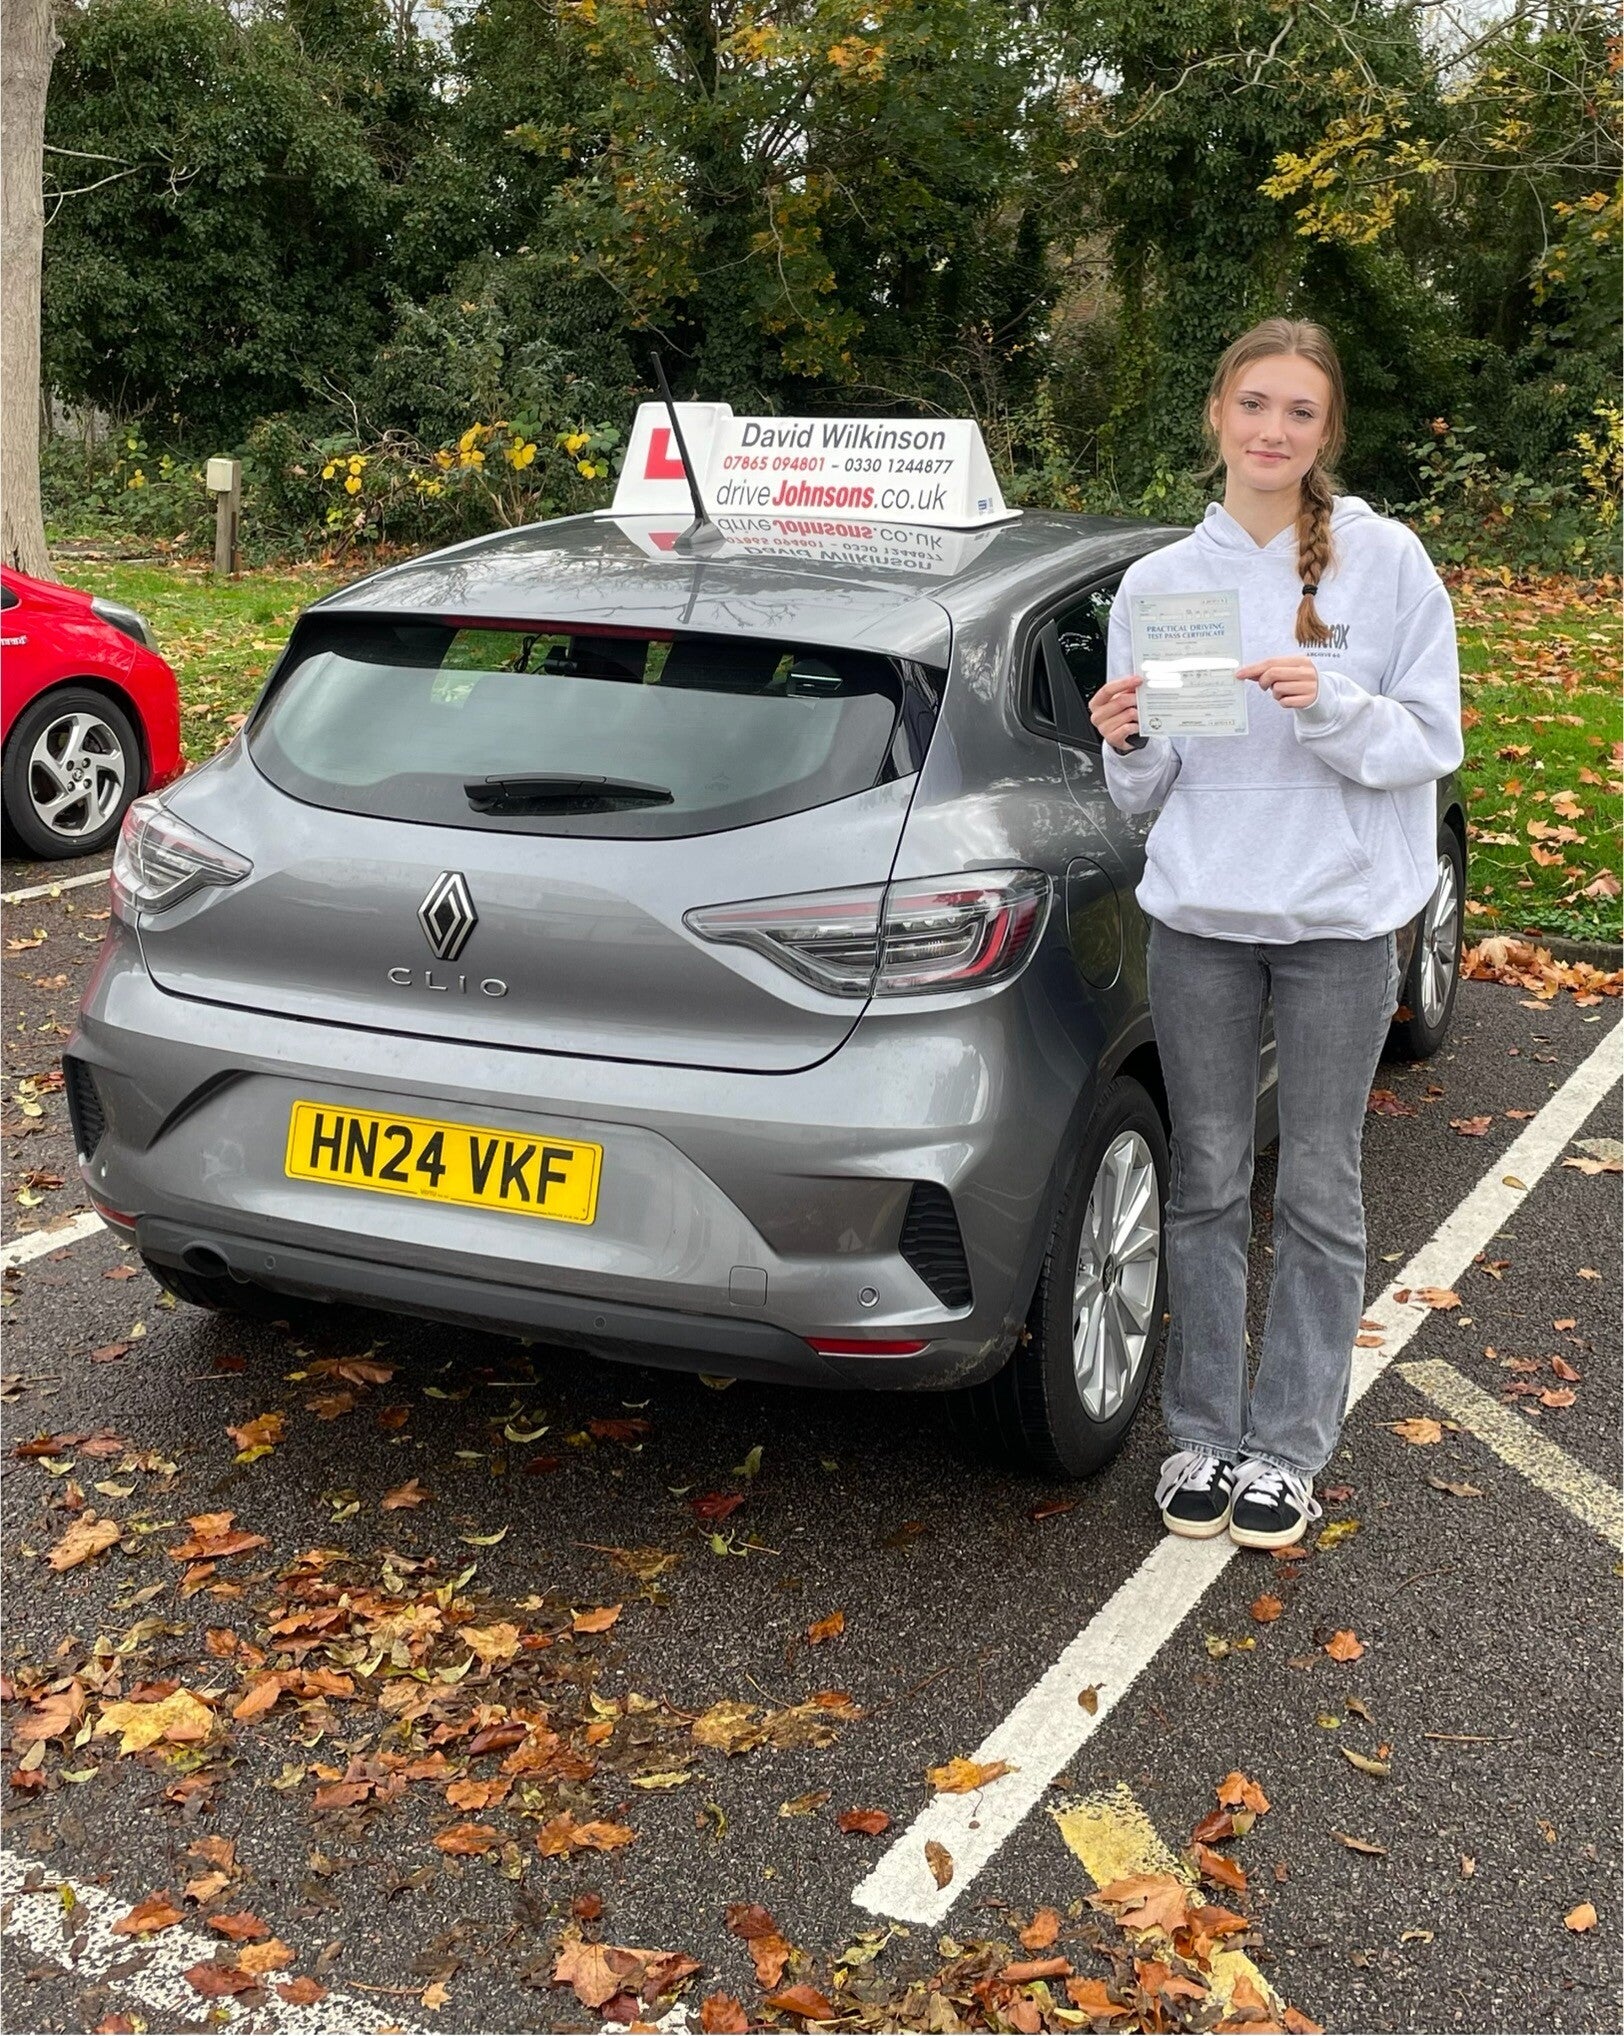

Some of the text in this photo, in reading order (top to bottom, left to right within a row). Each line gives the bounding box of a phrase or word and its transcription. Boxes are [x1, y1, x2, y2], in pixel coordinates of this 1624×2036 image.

[741, 422, 946, 450] David Wilkinson
[644, 428, 687, 479] L
[723, 456, 768, 470] 07865
[772, 457, 826, 472] 094801
[845, 458, 882, 472] 0330
[888, 459, 955, 474] 1244877
[1146, 622, 1225, 632] PRACTICAL DRIVING
[1182, 630, 1225, 638] CERTIFICATE
[387, 966, 508, 998] CLIO
[309, 1113, 574, 1205] HN24 VKF
